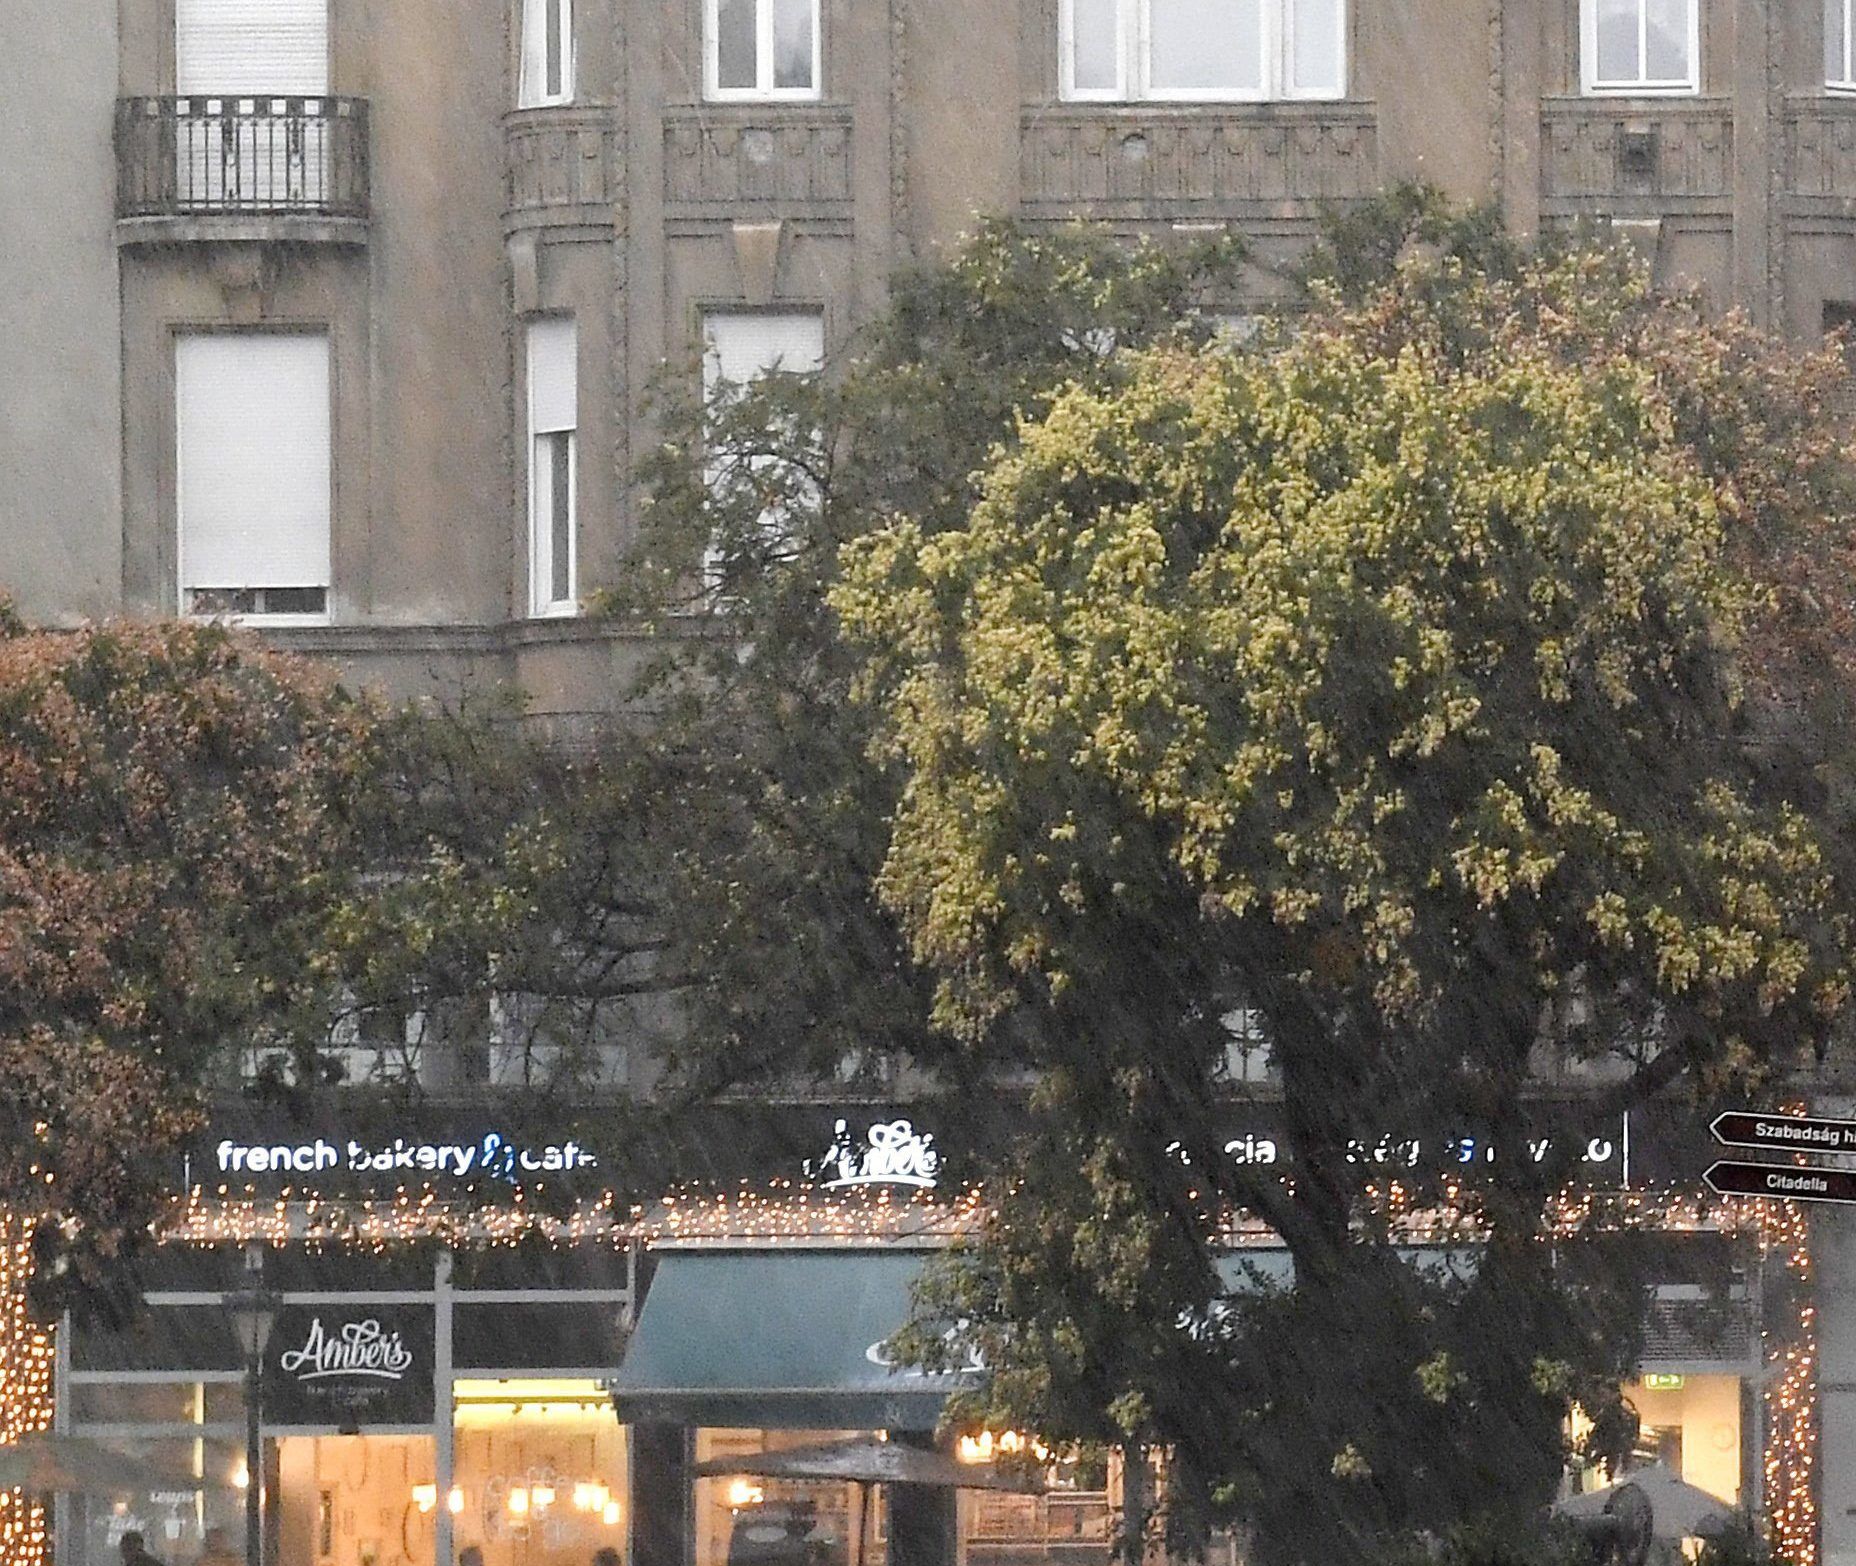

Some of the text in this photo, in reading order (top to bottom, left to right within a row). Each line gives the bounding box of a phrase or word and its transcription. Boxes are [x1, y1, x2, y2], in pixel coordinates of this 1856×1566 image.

[1755, 1122, 1839, 1146] Szabadság
[217, 1140, 337, 1172] french
[348, 1139, 475, 1176] bakery
[1766, 1173, 1828, 1191] Citadella
[281, 1318, 412, 1372] Amber's
